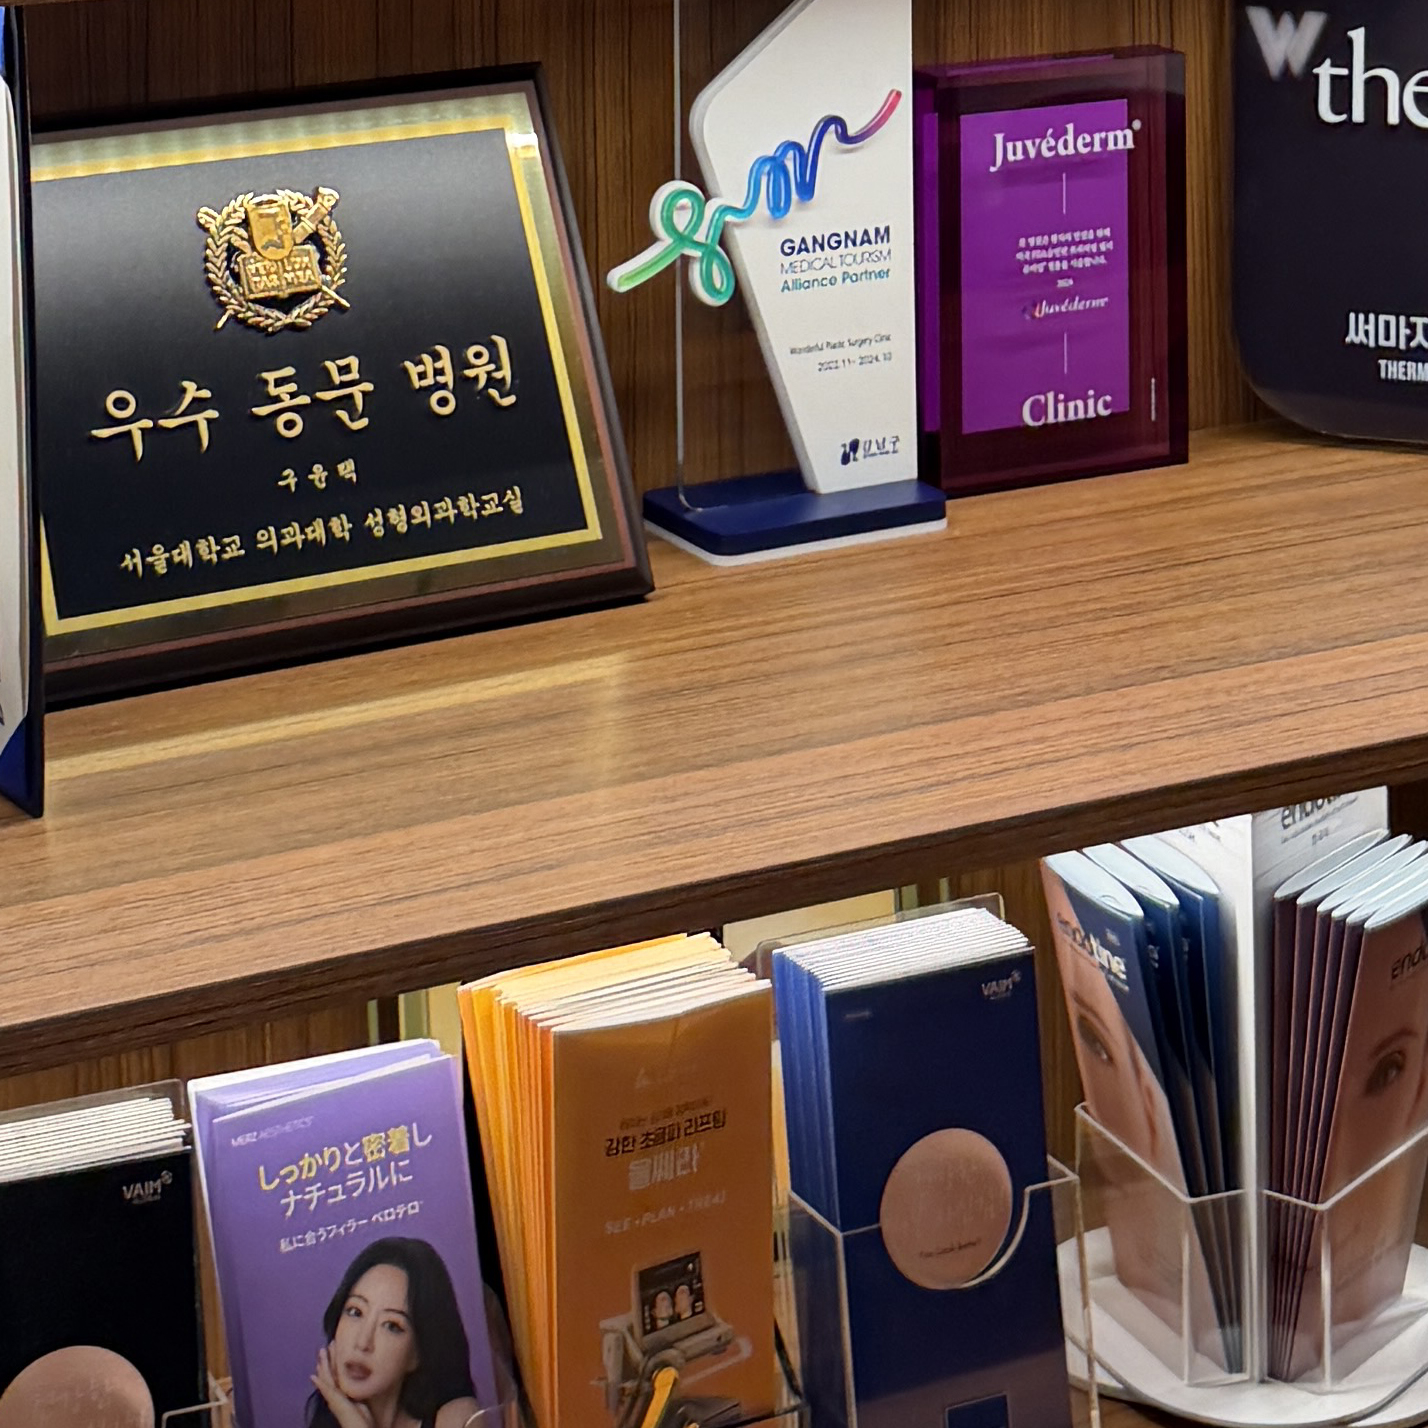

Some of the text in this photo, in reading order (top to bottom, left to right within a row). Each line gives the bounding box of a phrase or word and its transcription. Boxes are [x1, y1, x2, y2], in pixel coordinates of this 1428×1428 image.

[989, 122, 1136, 172] Juvéderm
[780, 225, 891, 257] GANGNAM
[780, 248, 891, 275] MEDICAL TOURISM
[781, 268, 891, 293] Alliance Partner
[89, 334, 518, 462] 우수 동문 병원
[1022, 388, 1113, 427] Clinic
[120, 485, 525, 578] 서울대학교 의과대학 성형외과학교실
[258, 1122, 433, 1191] しっかりと密着し
[122, 1178, 162, 1201] VAIM
[280, 1159, 414, 1218] ナチュラルに
